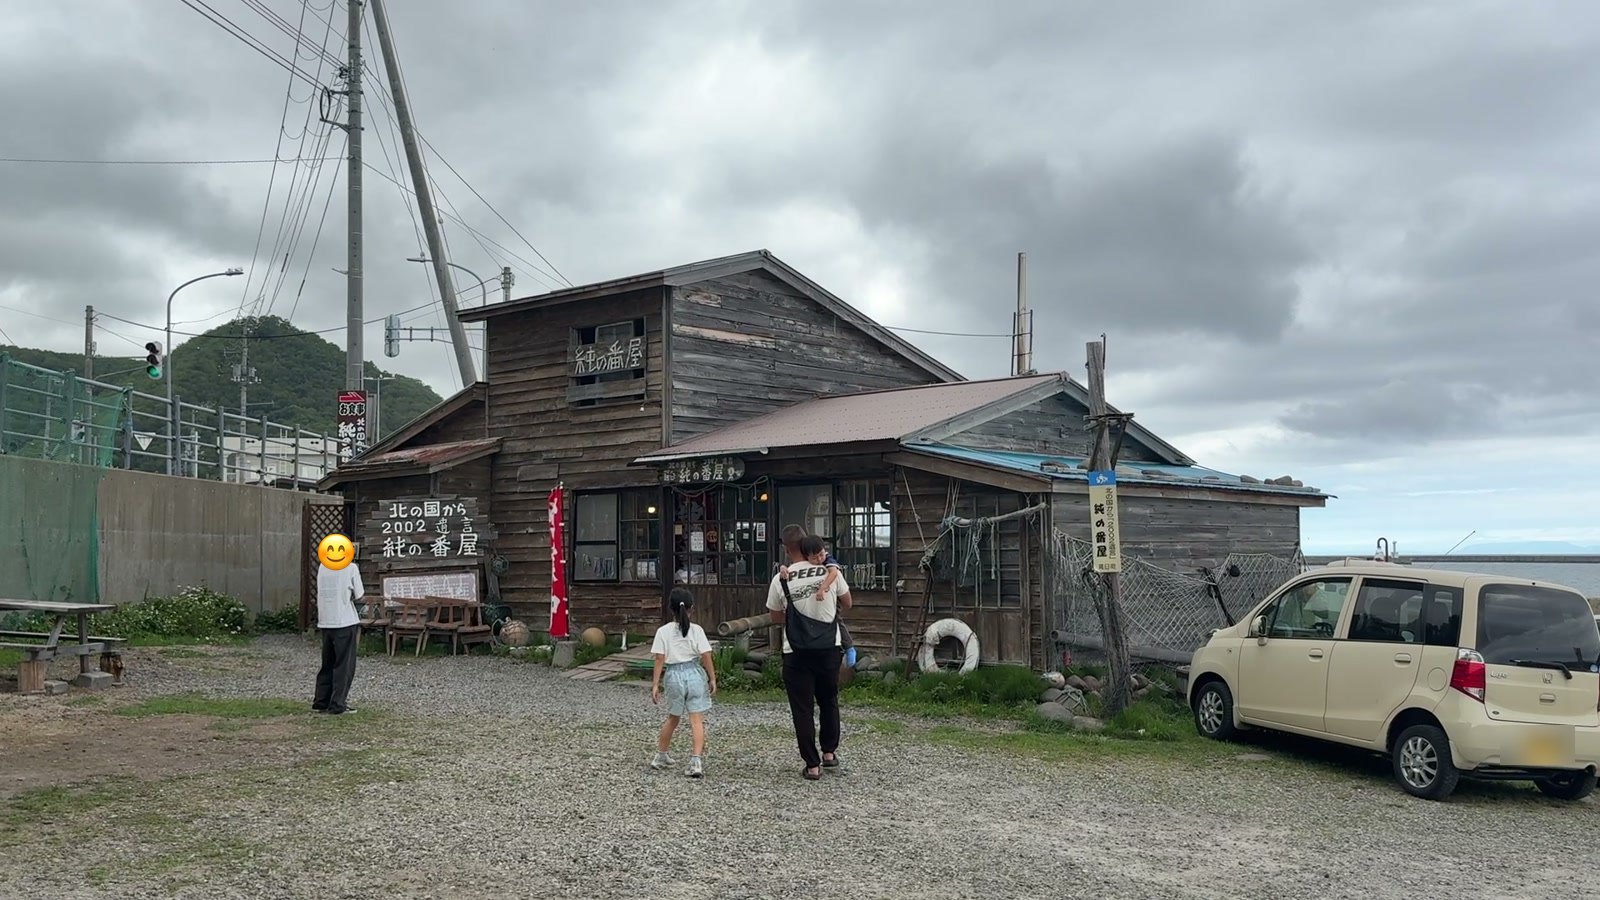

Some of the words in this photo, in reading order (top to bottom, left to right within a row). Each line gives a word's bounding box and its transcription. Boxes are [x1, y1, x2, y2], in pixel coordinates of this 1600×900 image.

[574, 338, 643, 374] 純の番屋
[339, 403, 365, 416] お食事
[389, 501, 466, 518] 北の国から
[381, 519, 426, 534] 2002
[1094, 503, 1107, 558] 純の番屋
[382, 533, 478, 558] 純の番屋
[788, 566, 827, 582] PEED
